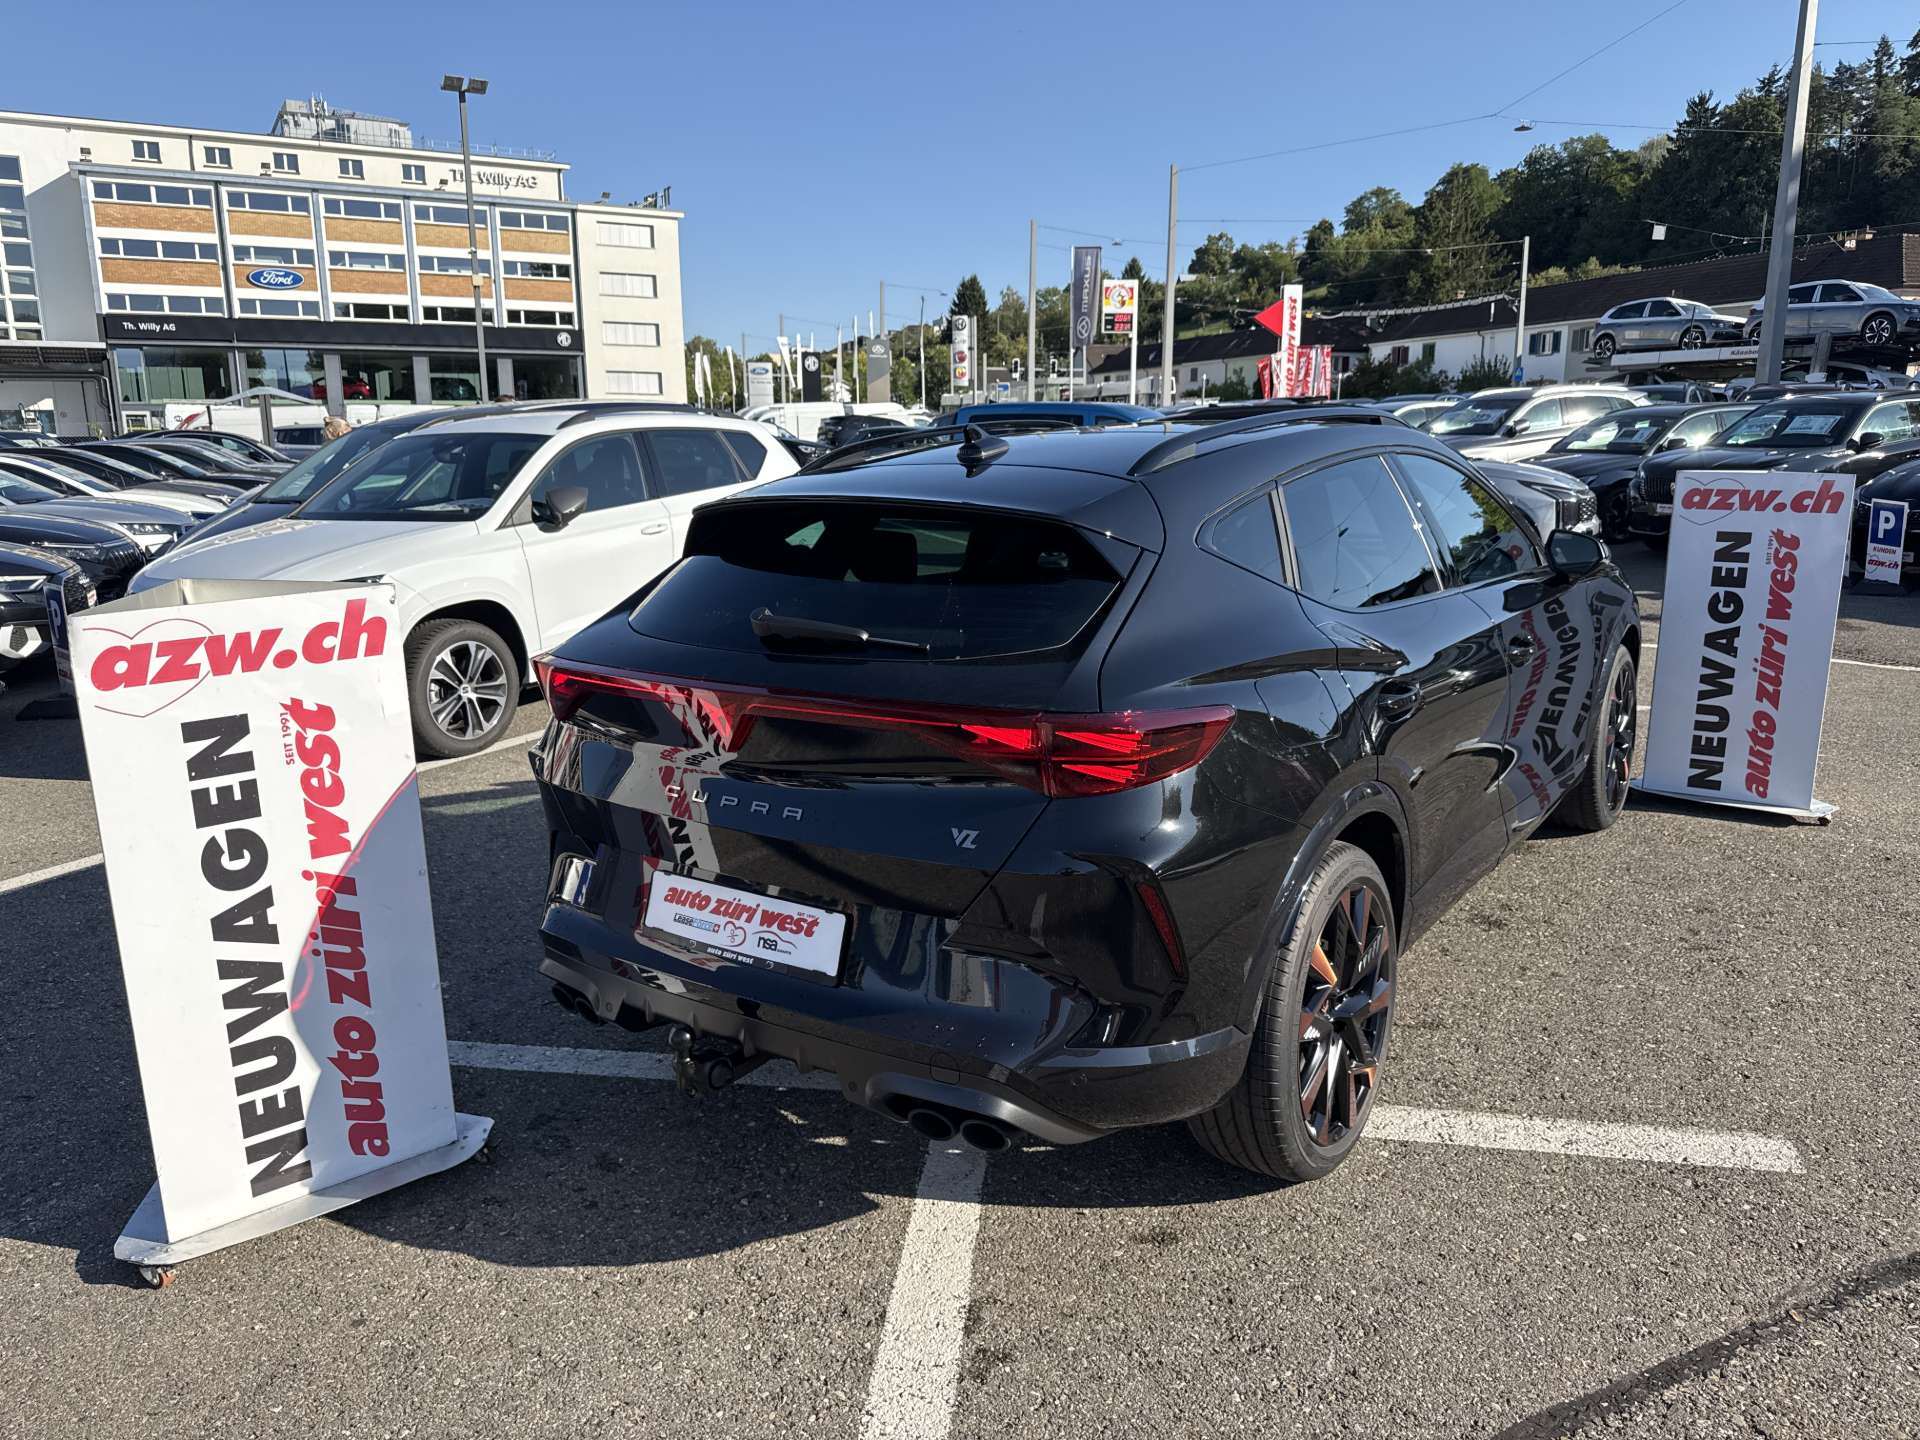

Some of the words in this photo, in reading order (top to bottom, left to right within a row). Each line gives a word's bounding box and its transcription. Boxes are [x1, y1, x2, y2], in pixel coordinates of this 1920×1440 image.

[477, 171, 511, 190] Willy
[1845, 239, 1856, 248] 48
[259, 268, 294, 285] Ford
[1081, 255, 1092, 313] MAXUS
[122, 321, 136, 331] Th.
[138, 322, 161, 334] Willy
[162, 322, 176, 332] AG
[1288, 296, 1298, 331] west
[805, 356, 819, 371] MG
[1681, 480, 1845, 514] azw.ch
[1877, 510, 1896, 539] P
[1867, 558, 1900, 570] azw.ch
[1872, 545, 1897, 556] KUNDEN
[1765, 528, 1800, 620] west
[92, 598, 387, 692] azw.ch
[1687, 530, 1752, 791] NEUWAGEN
[1752, 622, 1788, 712] züri
[279, 711, 292, 738] 1991
[283, 742, 296, 766] SEIT
[1745, 710, 1778, 799] auto
[279, 697, 354, 860] west
[665, 785, 803, 821] CUPRA
[951, 827, 981, 849] VZ
[664, 886, 712, 912] auto
[709, 897, 761, 924] züri
[759, 909, 820, 938] west
[300, 869, 373, 1007] züri
[757, 935, 778, 952] nsa
[180, 713, 315, 1198] NEUWAGEN
[707, 947, 722, 956] auto
[722, 951, 738, 960] züri
[737, 955, 754, 965] west
[323, 1014, 389, 1157] auto
